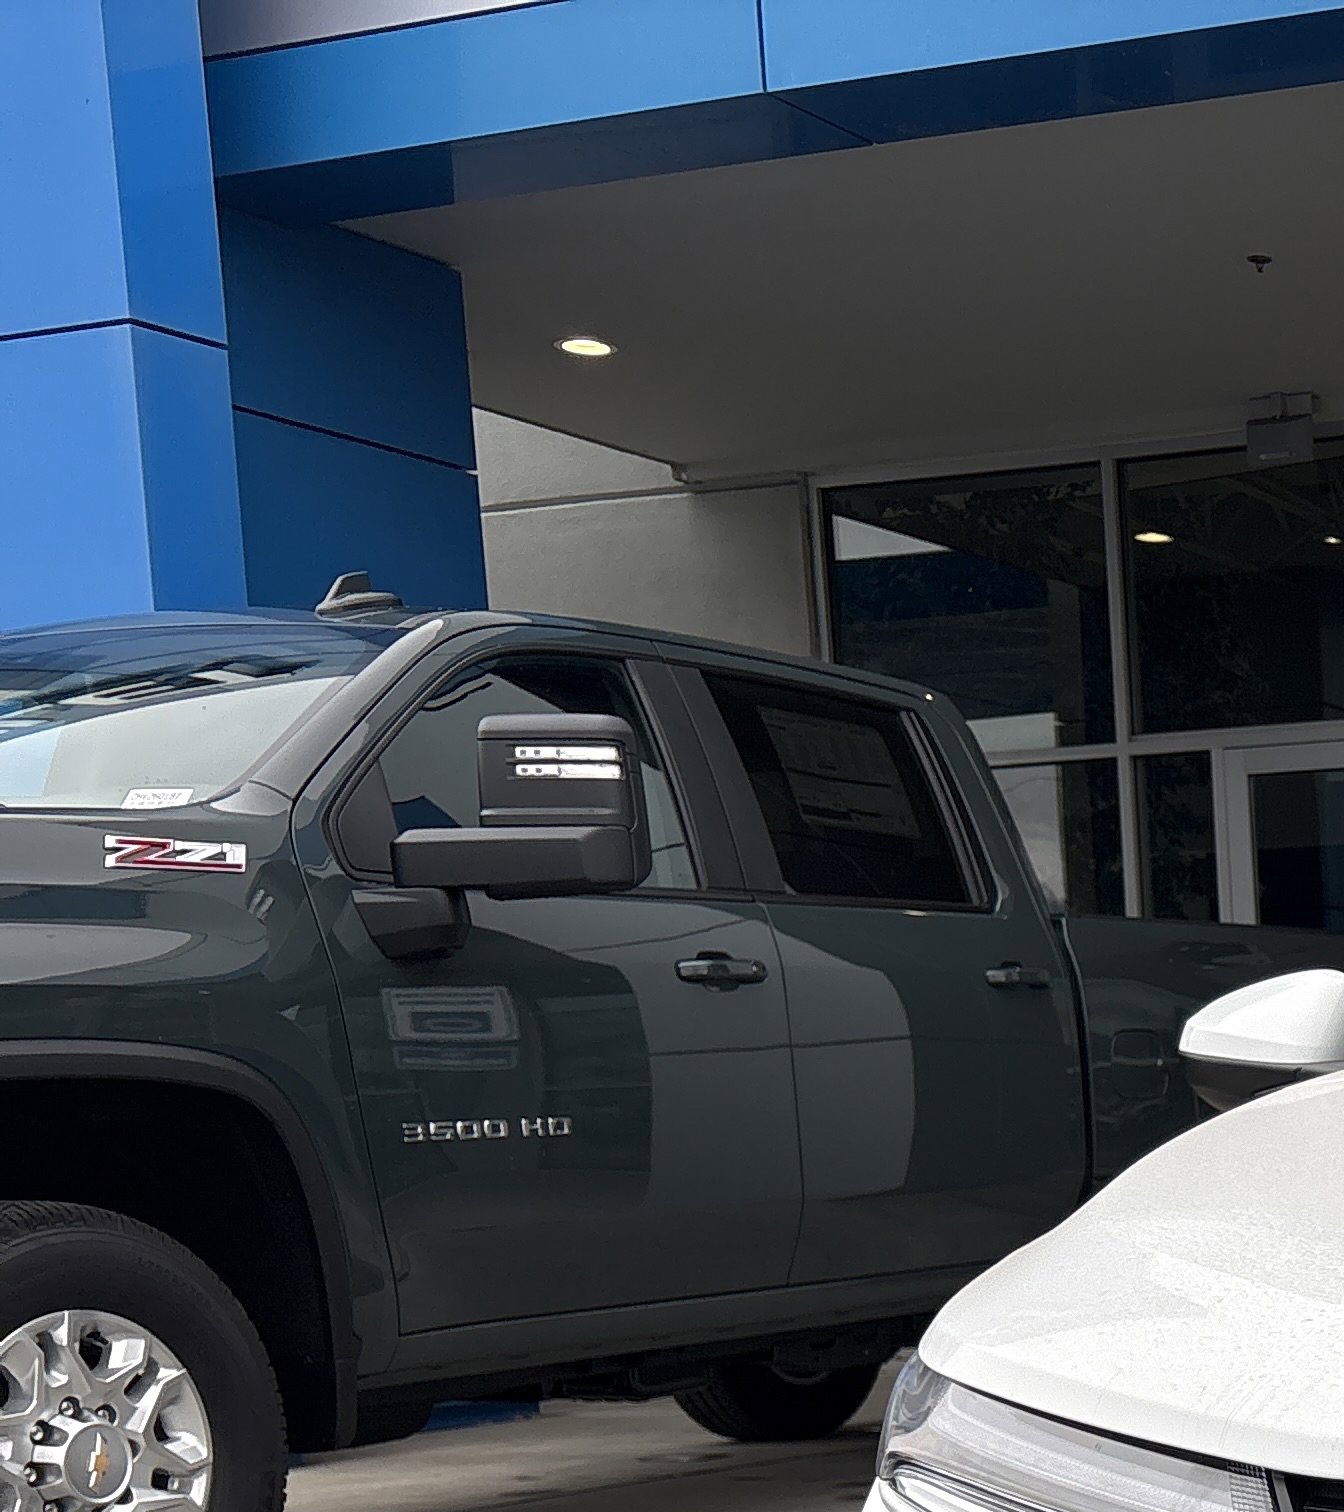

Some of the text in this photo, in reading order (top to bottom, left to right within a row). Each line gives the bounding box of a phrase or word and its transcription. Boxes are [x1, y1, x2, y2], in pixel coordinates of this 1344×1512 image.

[104, 834, 247, 873] Z71
[401, 1116, 573, 1144] 3500 HD
